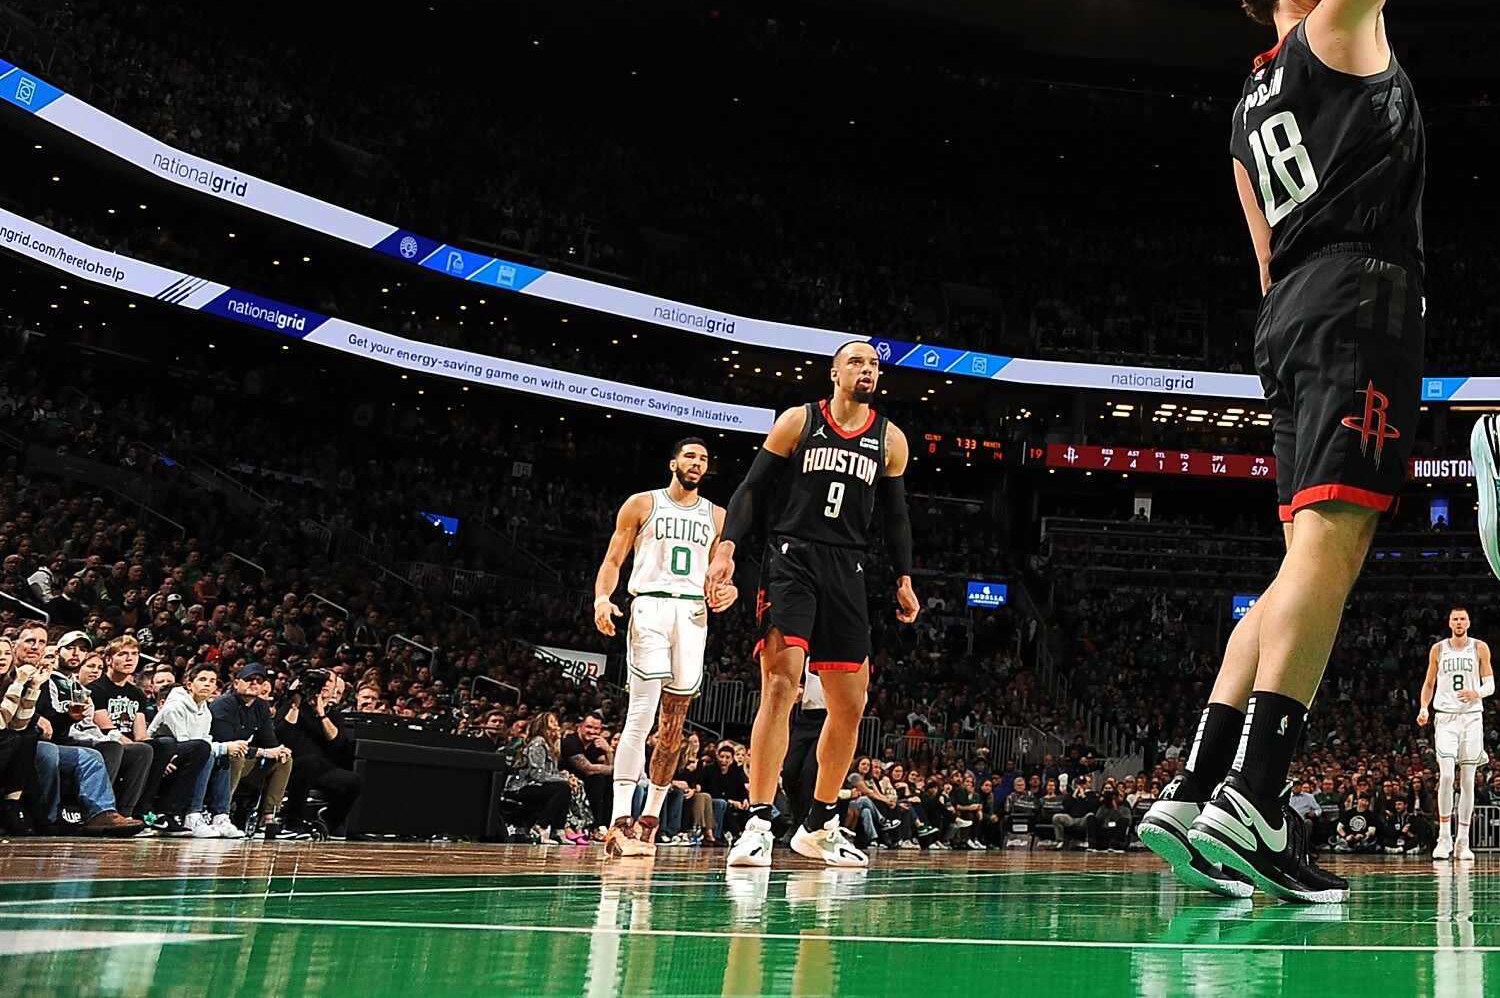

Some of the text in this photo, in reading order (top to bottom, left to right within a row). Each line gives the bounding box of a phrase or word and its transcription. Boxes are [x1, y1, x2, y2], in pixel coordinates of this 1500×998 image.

[152, 153, 248, 198] nationalgrid
[1249, 111, 1319, 227] 28
[227, 297, 306, 332] nationalgrid
[653, 304, 735, 335] nationalgrid
[348, 334, 743, 425] Get your energy-saving game on with our Customer Savings Initiative.
[1110, 370, 1194, 391] nationalgrid
[1030, 447, 1043, 460] 19
[1103, 456, 1111, 467] 7
[1129, 458, 1137, 469] 4
[802, 447, 878, 486] HOUSTON
[1157, 460, 1163, 470] 1
[1181, 461, 1188, 471] 2
[1211, 463, 1227, 474] 1/4
[1251, 464, 1269, 476] 5/9
[1414, 459, 1476, 478] HOUSTON
[824, 481, 846, 518] 9
[655, 517, 712, 547] CELTICS
[670, 546, 691, 576] 0
[1442, 657, 1473, 673] CELTICS
[1452, 674, 1464, 692] 8
